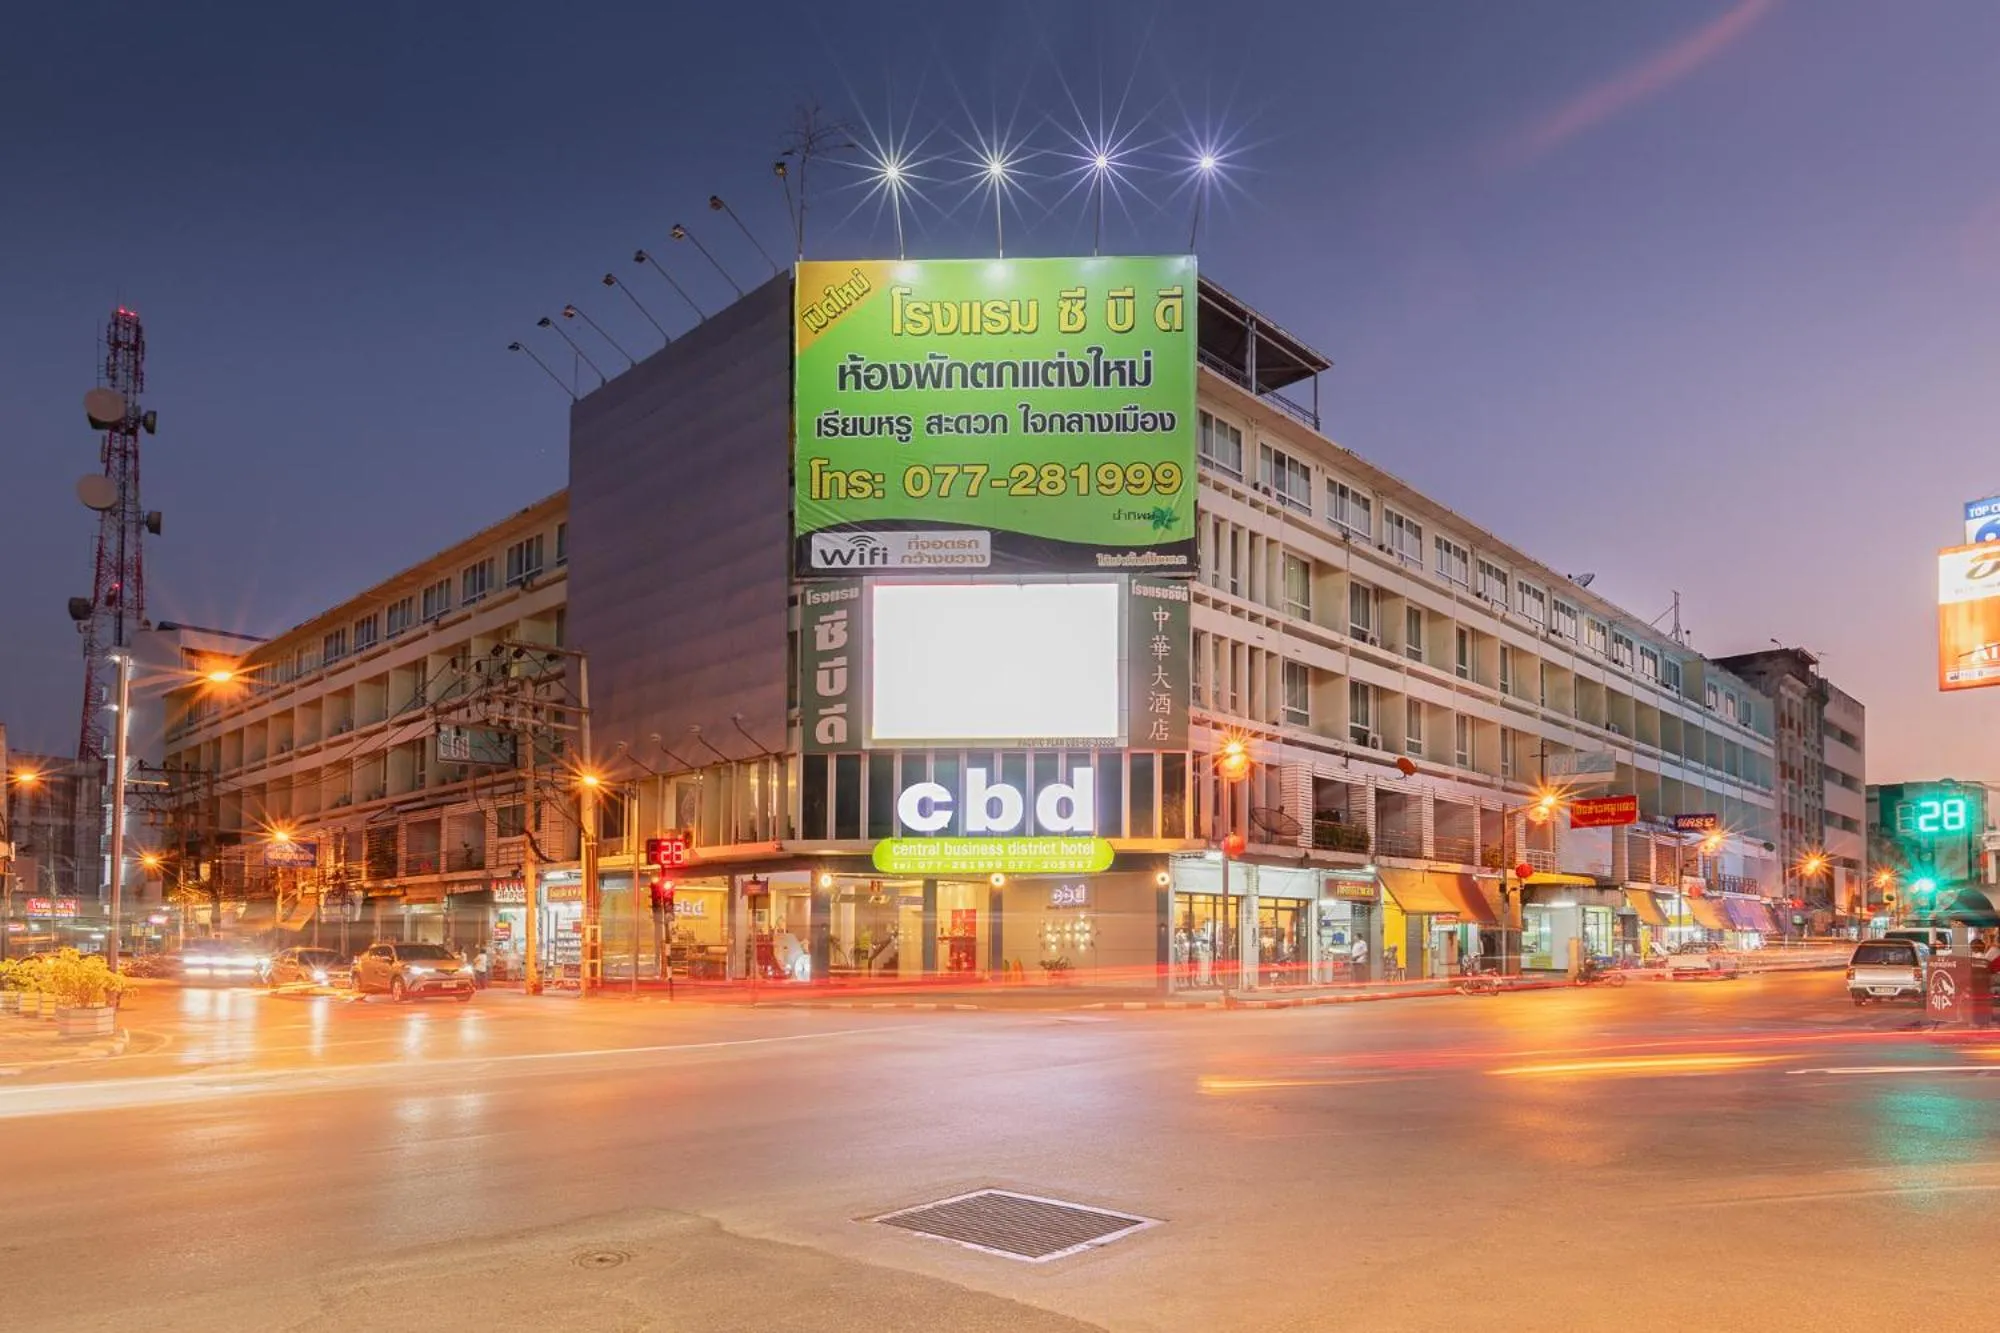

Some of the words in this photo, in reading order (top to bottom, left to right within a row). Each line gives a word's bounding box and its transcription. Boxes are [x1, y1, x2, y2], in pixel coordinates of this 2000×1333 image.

[801, 267, 872, 334] เปิดใหม่
[891, 286, 1039, 335] โรงแรม
[1058, 286, 1087, 333] ซี
[1106, 286, 1136, 333] บี
[1154, 285, 1184, 332] ดี
[837, 345, 1154, 392] ห้องพักตกแต่งใหม่
[816, 409, 913, 444] เรียบหรู
[925, 412, 1010, 436] สะดวก
[1017, 402, 1178, 435] ใจกลางเมือง
[809, 456, 886, 500] โทร:
[903, 460, 1184, 498] 077-281999
[1969, 504, 1989, 518] TOP
[806, 586, 860, 606] โรงแรม
[1149, 605, 1172, 743] 中華大酒店
[897, 767, 1094, 832] cbd
[1919, 800, 1966, 832] 28
[661, 841, 684, 864] 28
[893, 842, 940, 856] central
[944, 842, 1004, 856] business
[1008, 841, 1057, 856] district
[1061, 840, 1095, 856] hotel
